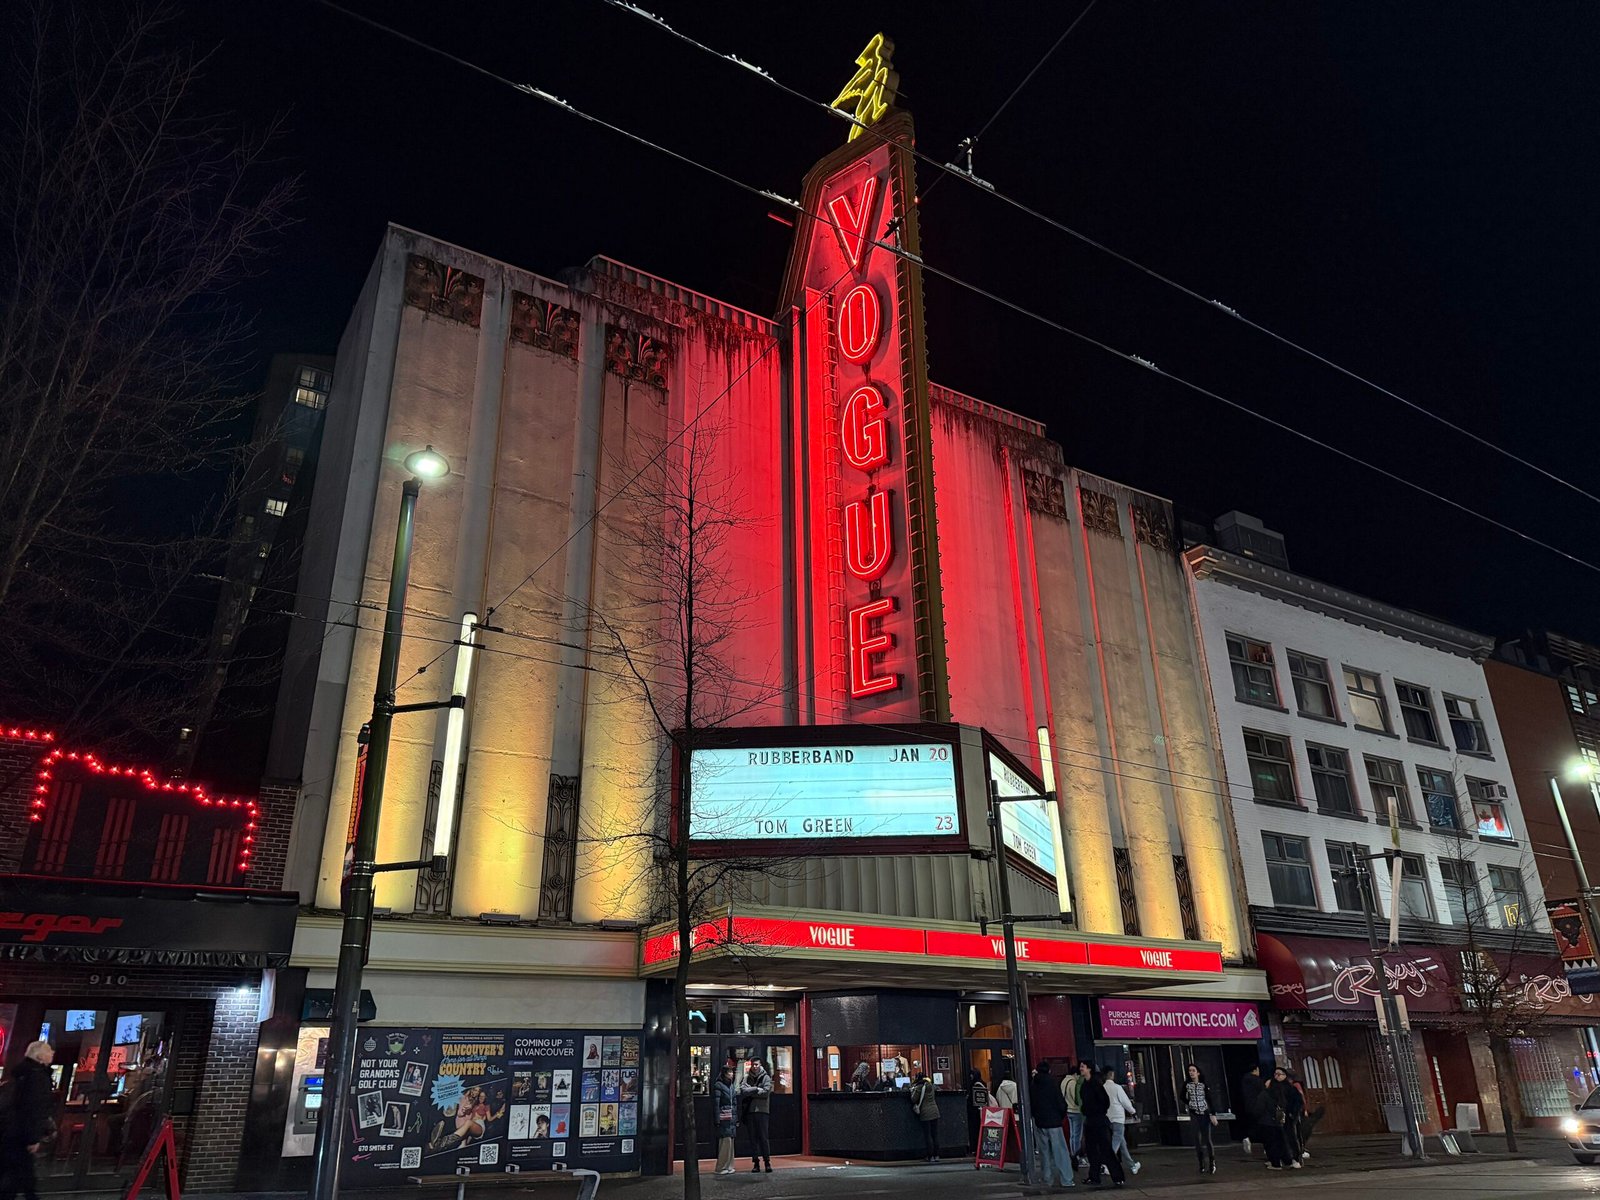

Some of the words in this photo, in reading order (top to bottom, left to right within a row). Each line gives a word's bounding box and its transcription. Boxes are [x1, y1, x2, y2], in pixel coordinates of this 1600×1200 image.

[827, 174, 901, 699] VOGUE
[749, 749, 854, 766] RUBBERBAND
[889, 747, 919, 763] JAN
[929, 747, 949, 761] 20
[755, 820, 787, 834] TOM
[803, 817, 852, 833] GREEN
[935, 816, 953, 830] 23
[809, 925, 855, 948] VOGUE
[991, 938, 1030, 959] VOUE
[1140, 949, 1174, 968] VOGUE
[89, 974, 128, 985] 910
[1108, 1010, 1141, 1019] PURCHASE
[1144, 1011, 1238, 1028] ADMITONE.COM
[1110, 1018, 1134, 1027] TICKETS
[515, 1038, 550, 1047] COMING
[551, 1038, 563, 1047] UP
[442, 1044, 504, 1056] VANCOUVER'S
[514, 1048, 523, 1056] IN
[524, 1047, 574, 1056] VANCOUVER
[361, 1059, 376, 1068] NOT
[378, 1059, 398, 1068] YOUR
[440, 1063, 487, 1076] COUNTRY
[360, 1069, 400, 1078] GRANDPA'S
[358, 1080, 377, 1089] GOLF
[378, 1080, 398, 1089] CLUB
